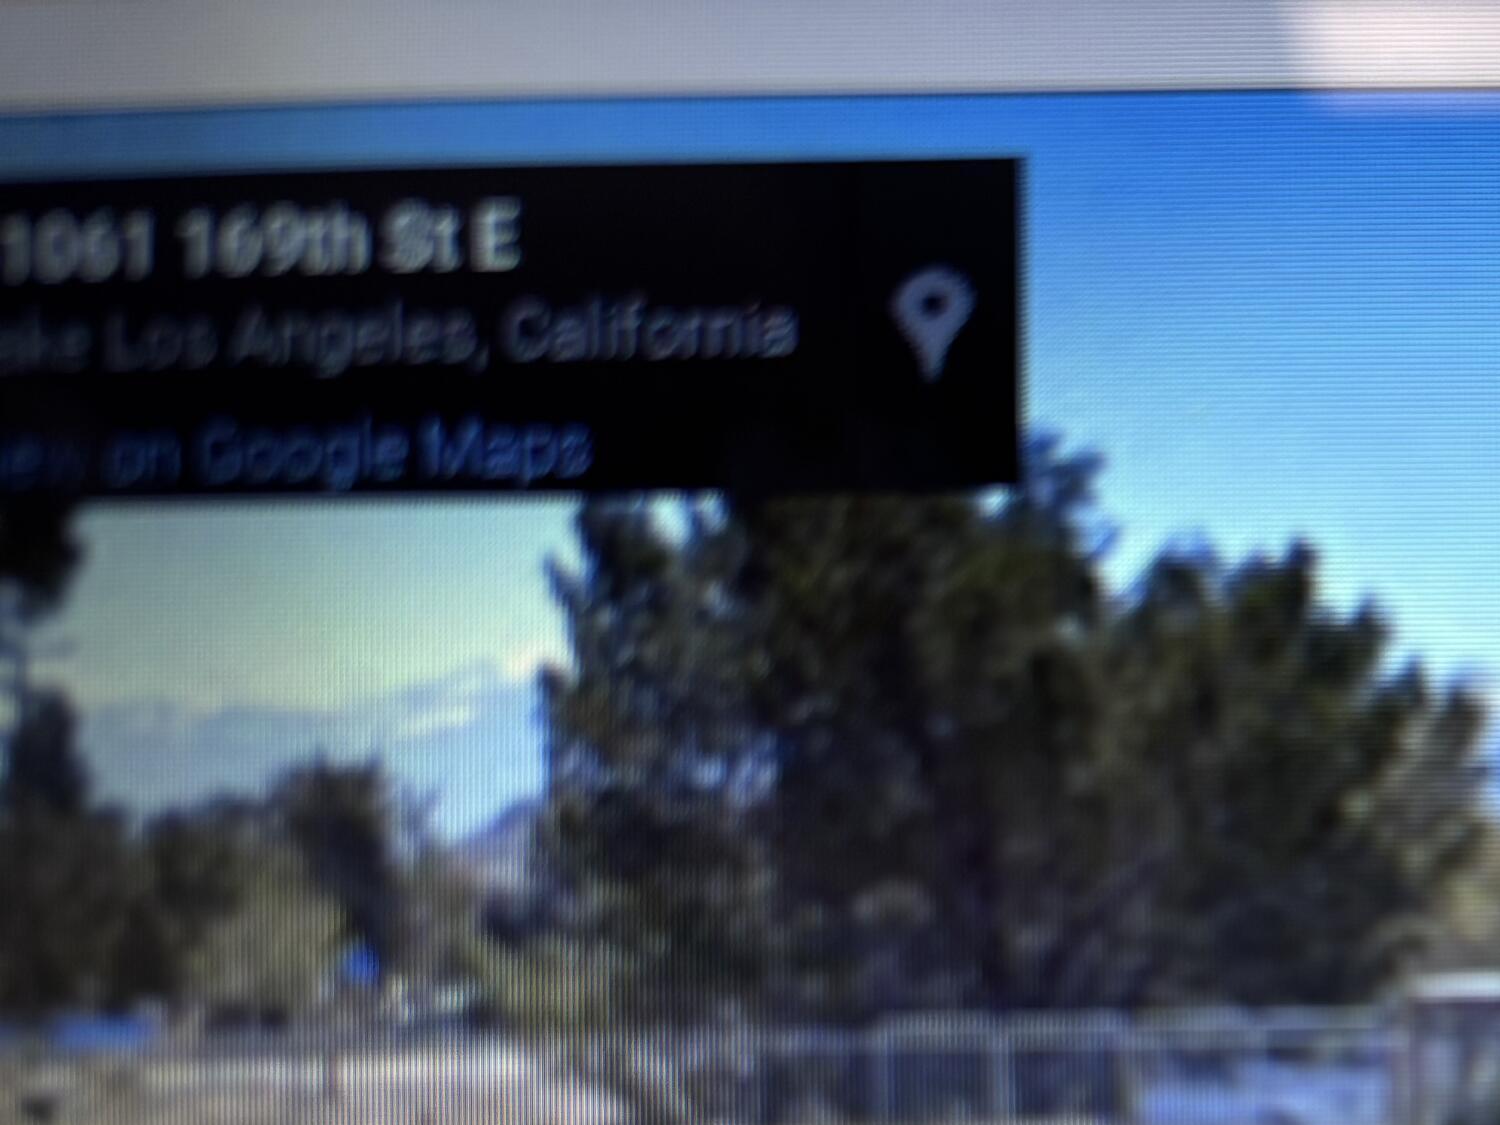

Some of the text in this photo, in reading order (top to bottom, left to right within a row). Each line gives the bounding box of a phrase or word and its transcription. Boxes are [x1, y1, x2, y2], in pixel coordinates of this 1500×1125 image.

[174, 201, 373, 279] 169th
[378, 197, 463, 275] St
[469, 194, 524, 274] E
[102, 304, 220, 374] Los
[226, 296, 491, 379] Angeles,
[498, 291, 799, 364] California
[102, 426, 183, 489] on
[198, 408, 409, 491] Google
[416, 411, 594, 486] Maps
